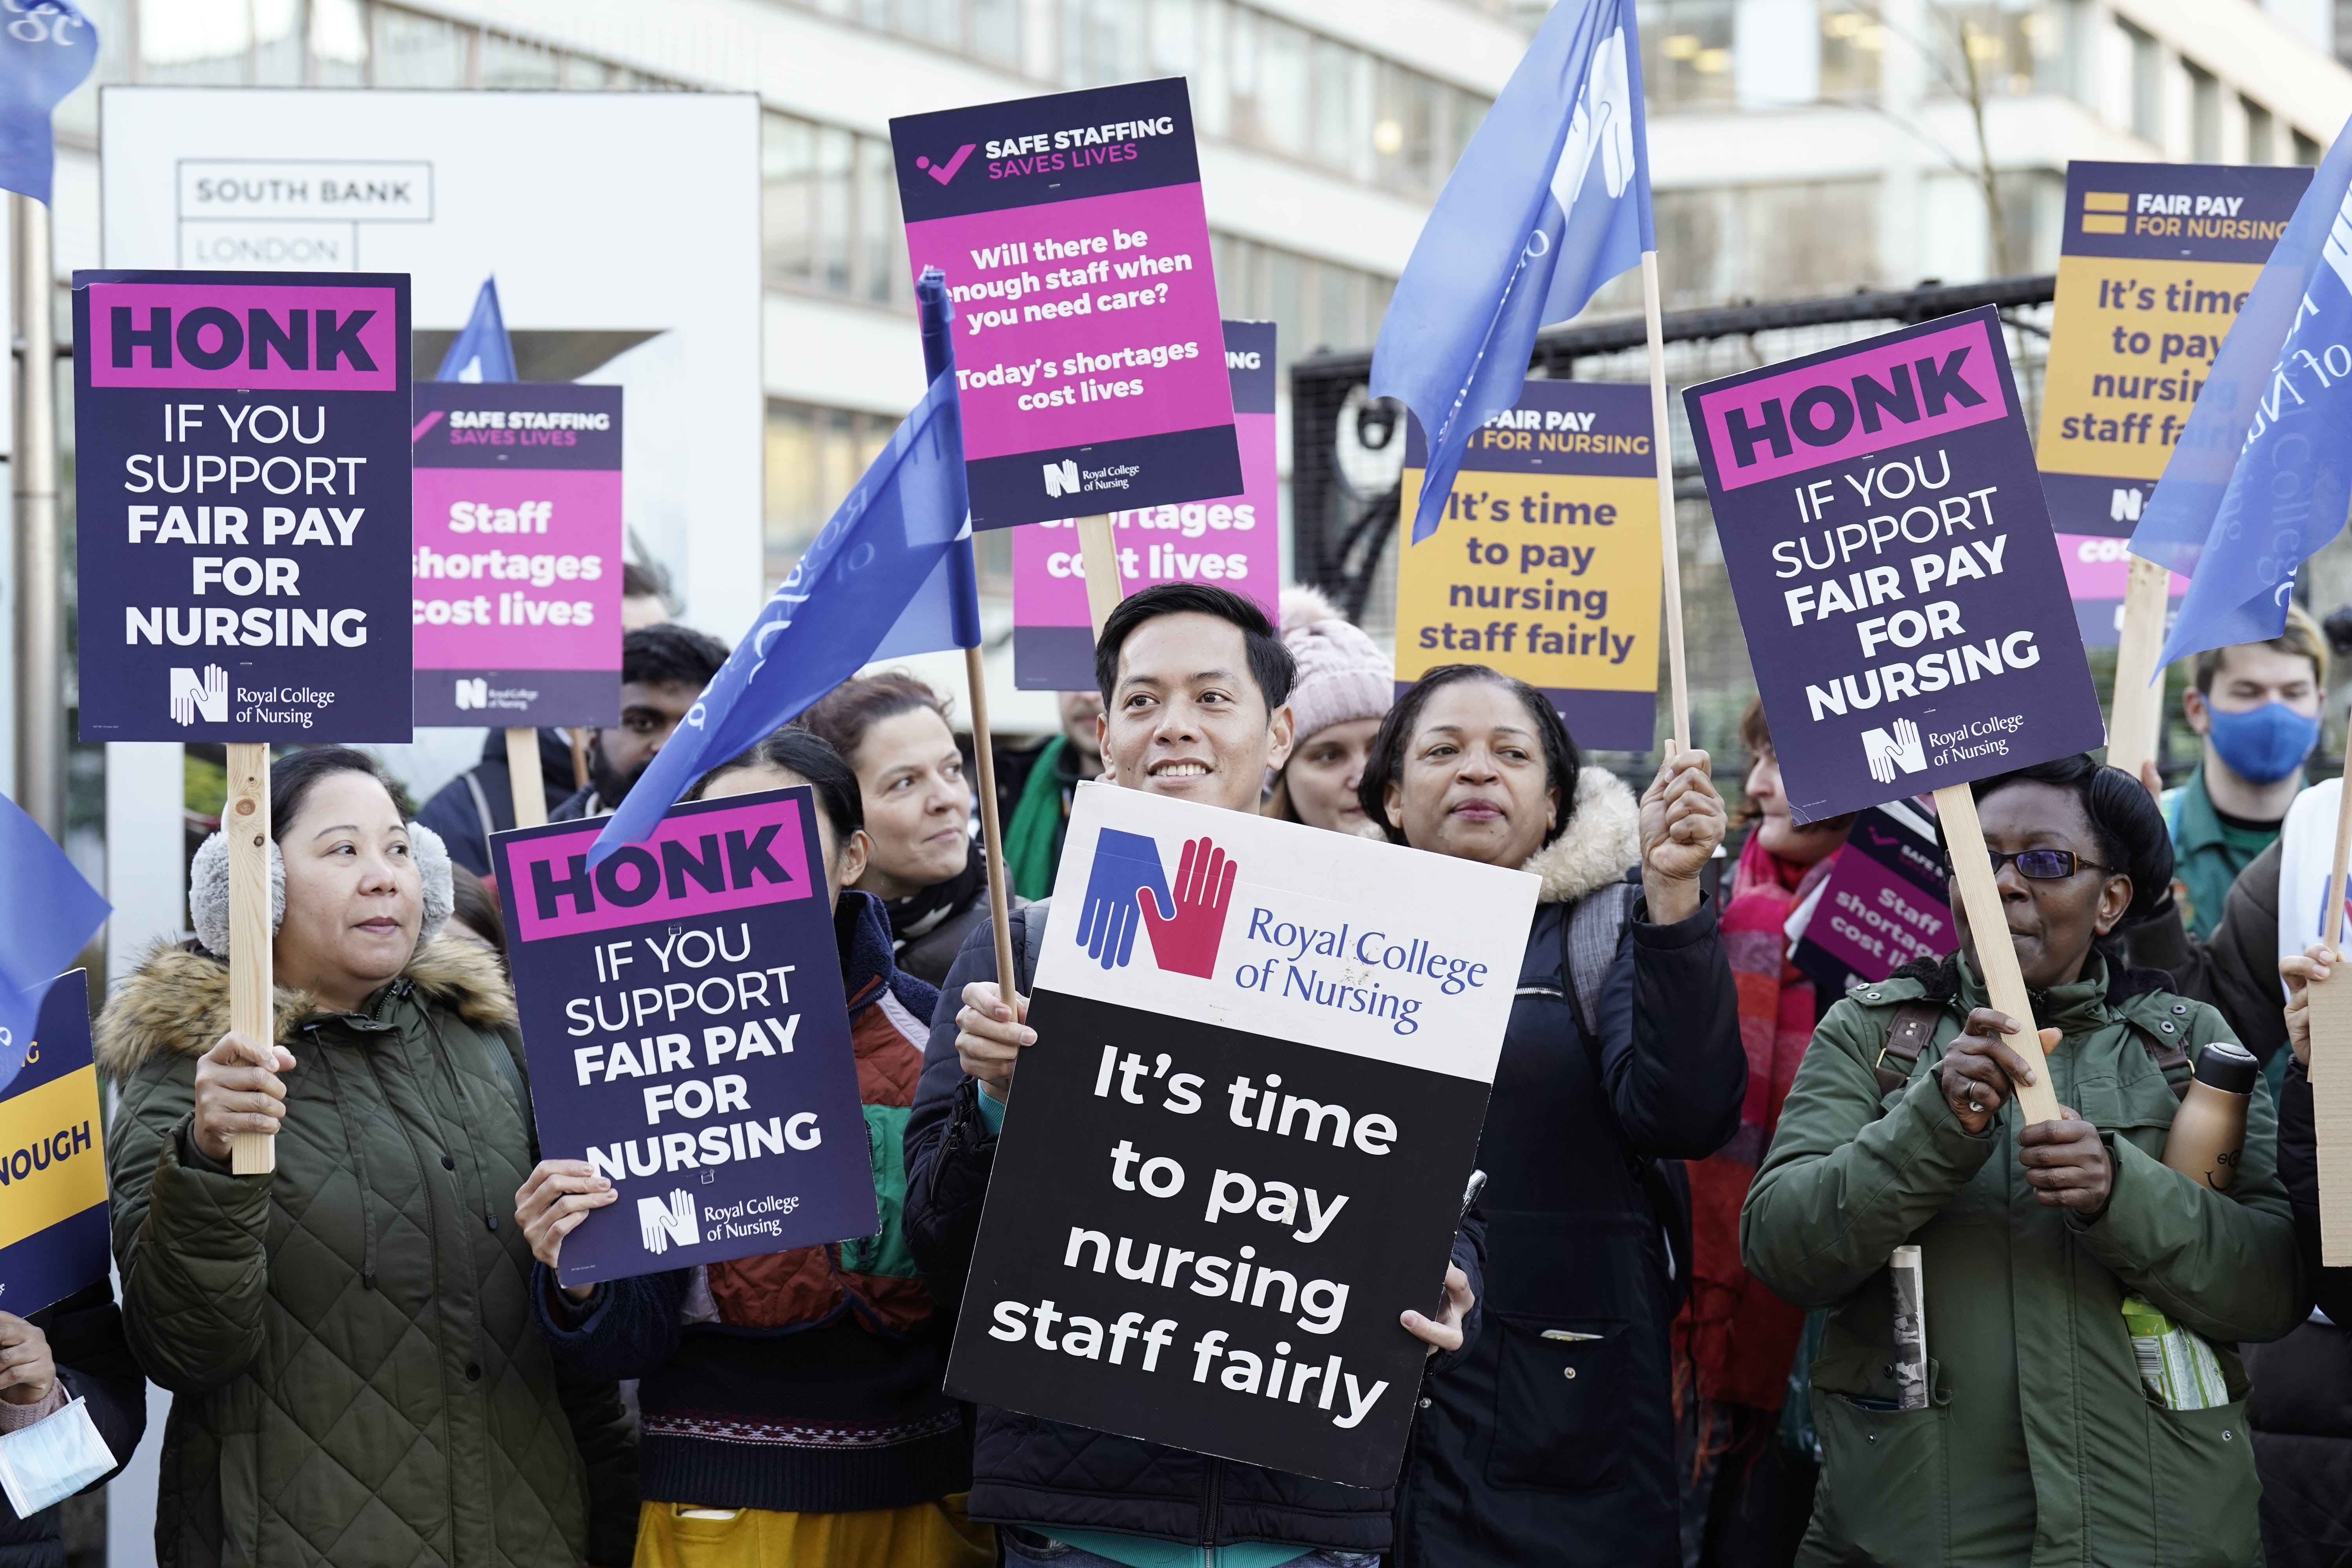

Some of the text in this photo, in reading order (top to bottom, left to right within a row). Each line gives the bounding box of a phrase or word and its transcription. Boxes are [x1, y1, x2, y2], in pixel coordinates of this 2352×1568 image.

[986, 117, 1173, 158] SAFE STAFFING
[989, 143, 1137, 179] SAVES LIVES
[196, 179, 412, 203] SOUTH BANK
[2136, 193, 2244, 217] FAIR PAY
[2135, 216, 2181, 236] FOR
[196, 237, 339, 262] LONDON
[971, 229, 1147, 269] Will there be
[1045, 260, 1109, 289] staff
[1113, 254, 1192, 279] when
[967, 283, 1168, 335] you need care?
[2099, 279, 2250, 314] It's time
[111, 306, 378, 371] HONK
[2112, 327, 2151, 354] to
[956, 359, 1057, 390] Today's
[1063, 342, 1198, 375] shortages
[1018, 379, 1143, 410] cost lives
[2092, 369, 2205, 403] nursi
[165, 405, 324, 444] IF YOU
[450, 411, 610, 430] SAFE STAFFING
[1546, 411, 1596, 432] PAY
[1724, 347, 1987, 468] HONK
[450, 430, 577, 446] SAVES LIVES
[1483, 430, 1650, 456] FOR NURSING
[2061, 412, 2153, 444] staff
[125, 455, 366, 495] SUPPORT
[1083, 465, 1139, 481] Royal College
[1084, 479, 1129, 491] of Nursing
[1795, 450, 1950, 523] IF YOU
[129, 506, 365, 545] FAIR PAY
[448, 501, 553, 534] Staff
[1039, 503, 1255, 537] rtages
[1449, 491, 1616, 525] It's time
[1773, 486, 1997, 577] SUPPORT
[193, 557, 300, 595] FOR
[412, 545, 602, 588] hortages
[1047, 543, 1248, 579] cot lives
[1467, 538, 1595, 575] to pay
[1450, 579, 1607, 620] nursing
[1784, 534, 2007, 626] FAIR PAY
[127, 607, 367, 647] NURSING
[412, 591, 594, 626] cost lives
[1420, 622, 1635, 664] staff fairly
[1857, 601, 1965, 658] FOR
[1806, 631, 2040, 721] NURSING
[238, 687, 334, 708] Royal College
[236, 707, 312, 728] of Nursing
[1929, 715, 2024, 748] Royal College
[1935, 739, 2009, 766] of Nursing
[530, 823, 793, 920] HONK
[1835, 891, 1944, 966] shortag
[1878, 887, 1943, 936] Staff
[595, 923, 750, 982] IF YOU
[1248, 908, 1487, 995] Royal College
[566, 965, 795, 1036] SUPPORT
[1236, 959, 1422, 1035] of Nursing
[574, 1014, 800, 1085] FAIR PAY
[644, 1075, 751, 1125] FOR
[1094, 1045, 1397, 1155] It's time
[586, 1112, 821, 1180] NURSING
[704, 1196, 799, 1224] Royal College
[1111, 1140, 1349, 1243] to pay
[708, 1219, 782, 1241] of Nursing
[1064, 1227, 1349, 1334] nursing
[988, 1300, 1389, 1428] staff fairly
